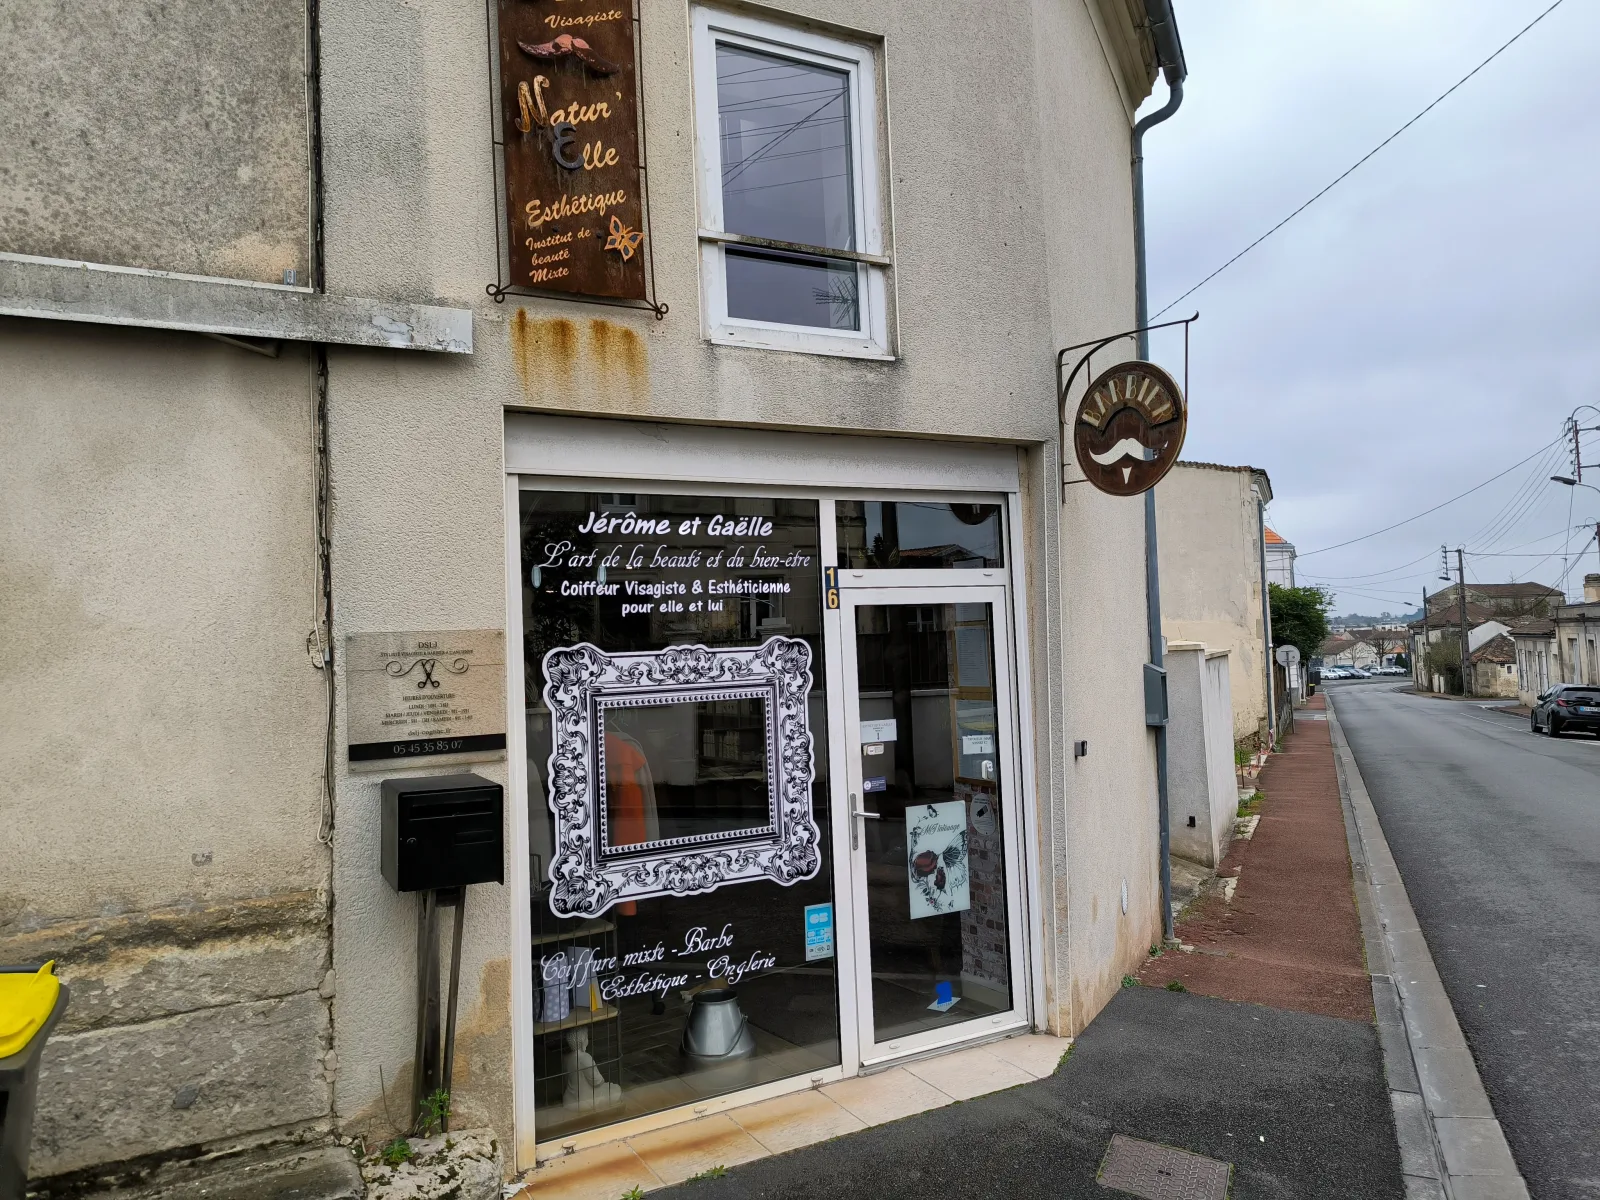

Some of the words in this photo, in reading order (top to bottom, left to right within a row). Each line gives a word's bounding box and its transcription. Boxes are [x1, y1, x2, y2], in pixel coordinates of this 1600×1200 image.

[544, 9, 623, 29] Visagiste
[552, 121, 620, 170] Elle
[525, 189, 627, 227] Esthétique
[525, 231, 573, 251] Institut
[577, 227, 592, 239] de
[531, 248, 571, 266] beauté
[528, 267, 570, 283] Mixte
[1081, 374, 1174, 427] BARBIER
[578, 511, 672, 535] Jérôme
[678, 516, 701, 536] et
[707, 514, 773, 537] Gaëlle
[537, 540, 599, 568] L'art
[601, 544, 623, 567] de
[626, 544, 644, 568] la
[649, 544, 702, 568] beauté
[706, 549, 725, 568] et
[726, 545, 745, 568] du
[749, 545, 811, 568] bien-être
[560, 579, 620, 596] Coiffeur
[624, 580, 687, 599] Visagiste
[691, 579, 703, 594] &
[708, 579, 791, 594] Esthéticienne
[621, 602, 655, 617] pour
[659, 599, 684, 613] elle
[688, 600, 703, 612] et
[707, 599, 723, 612] lui
[393, 744, 406, 754] 05
[408, 743, 420, 753] 45
[422, 742, 434, 752] 35
[436, 740, 449, 751] 85
[451, 740, 463, 749] 07
[540, 946, 617, 990] Coiffure
[622, 941, 665, 967] mixte
[677, 923, 734, 957] Barbe
[600, 972, 688, 1000] Esthétique
[706, 950, 776, 985] Onglerie
